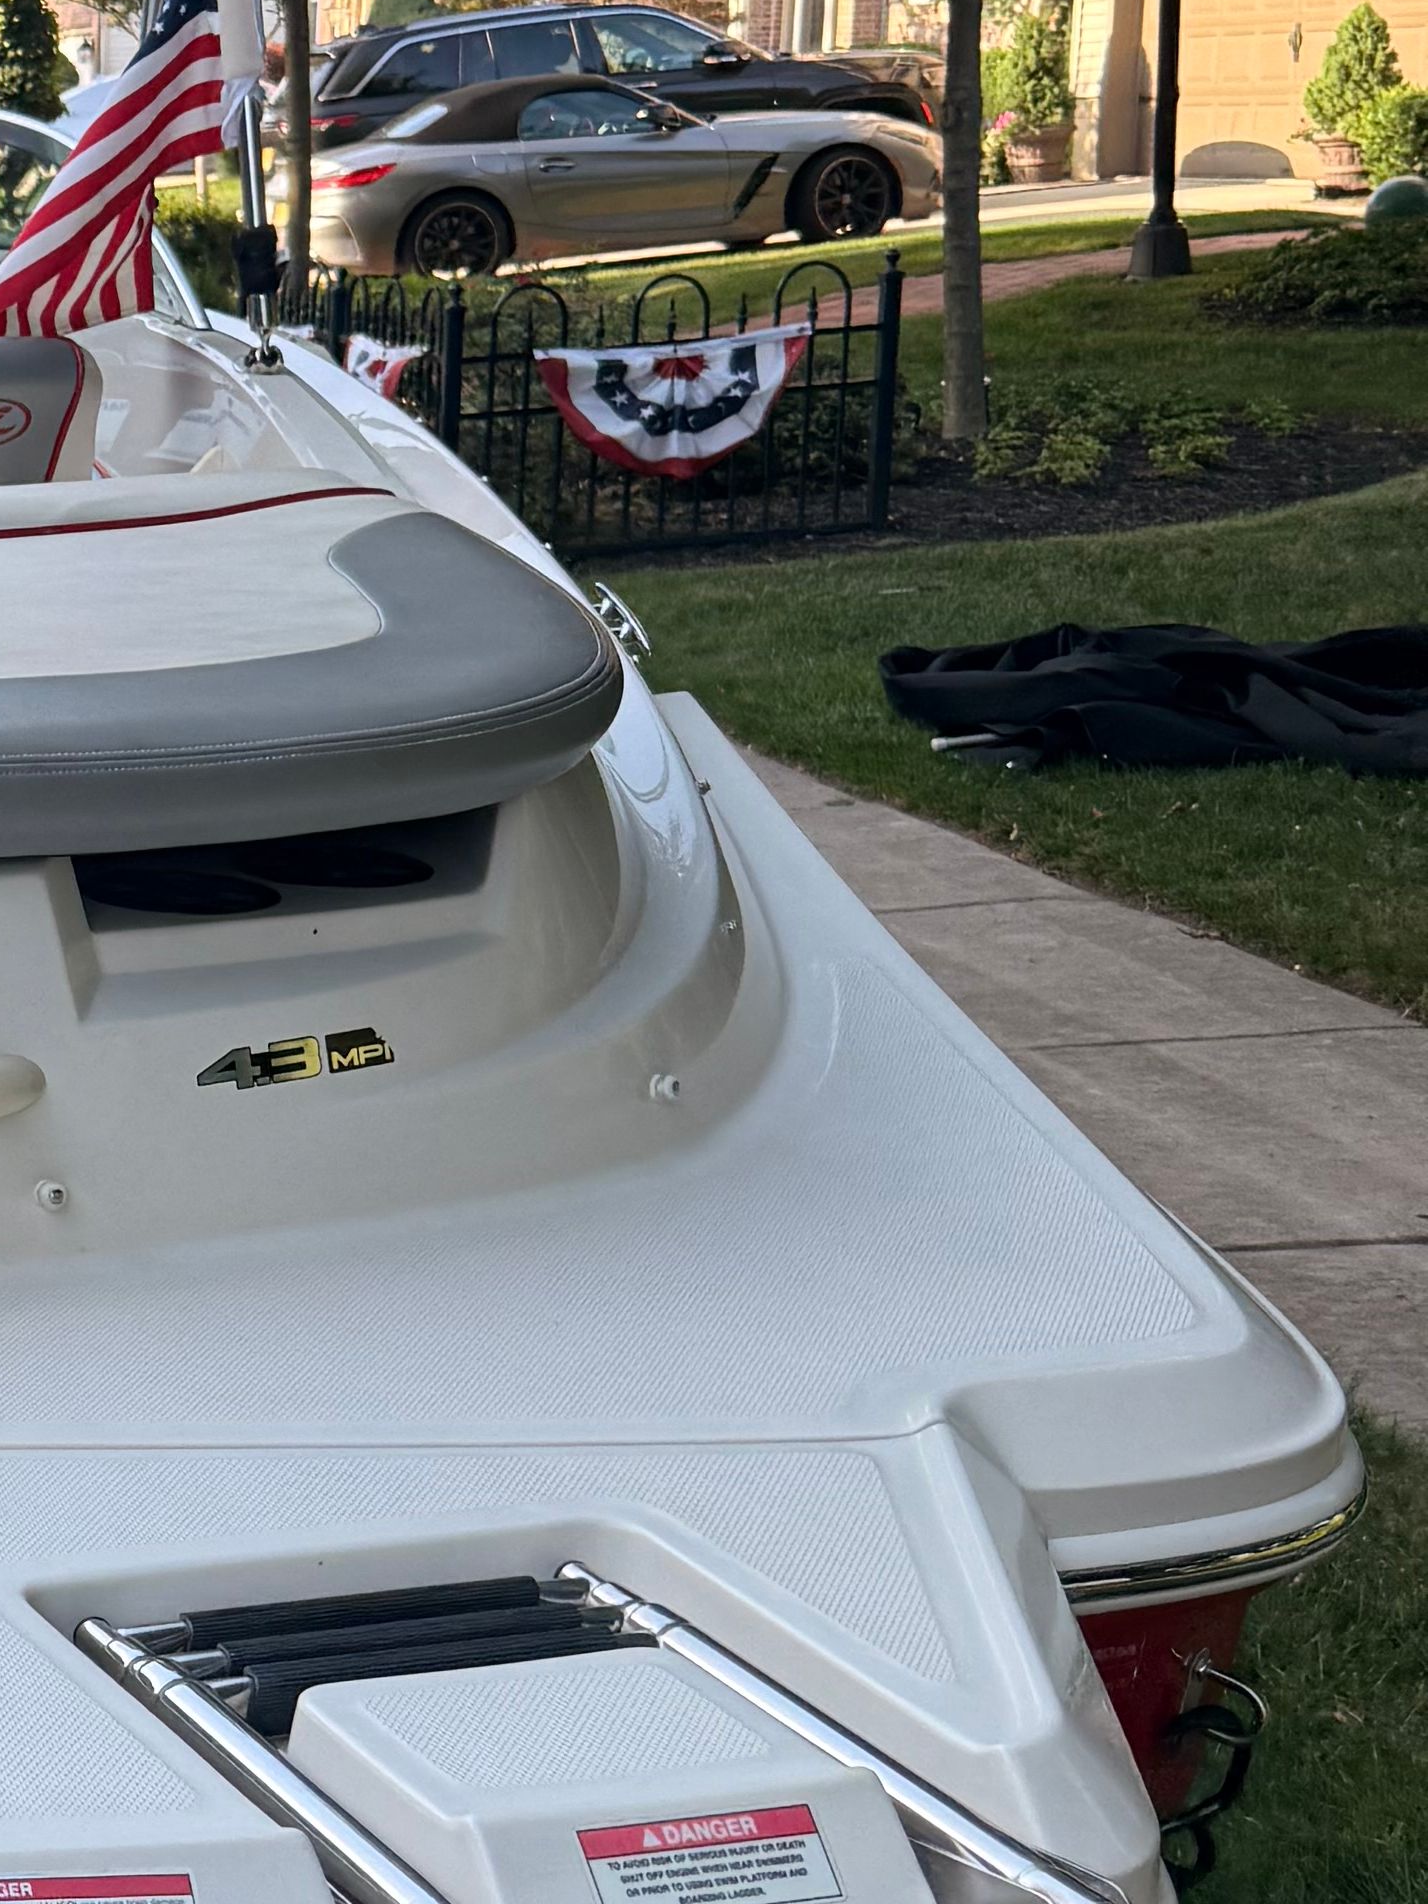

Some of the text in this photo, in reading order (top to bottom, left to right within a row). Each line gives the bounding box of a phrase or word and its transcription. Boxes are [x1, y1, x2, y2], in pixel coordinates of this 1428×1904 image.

[196, 1035, 322, 1090] 4.3
[661, 1815, 759, 1844] DANGER
[607, 1861, 621, 1871] TO
